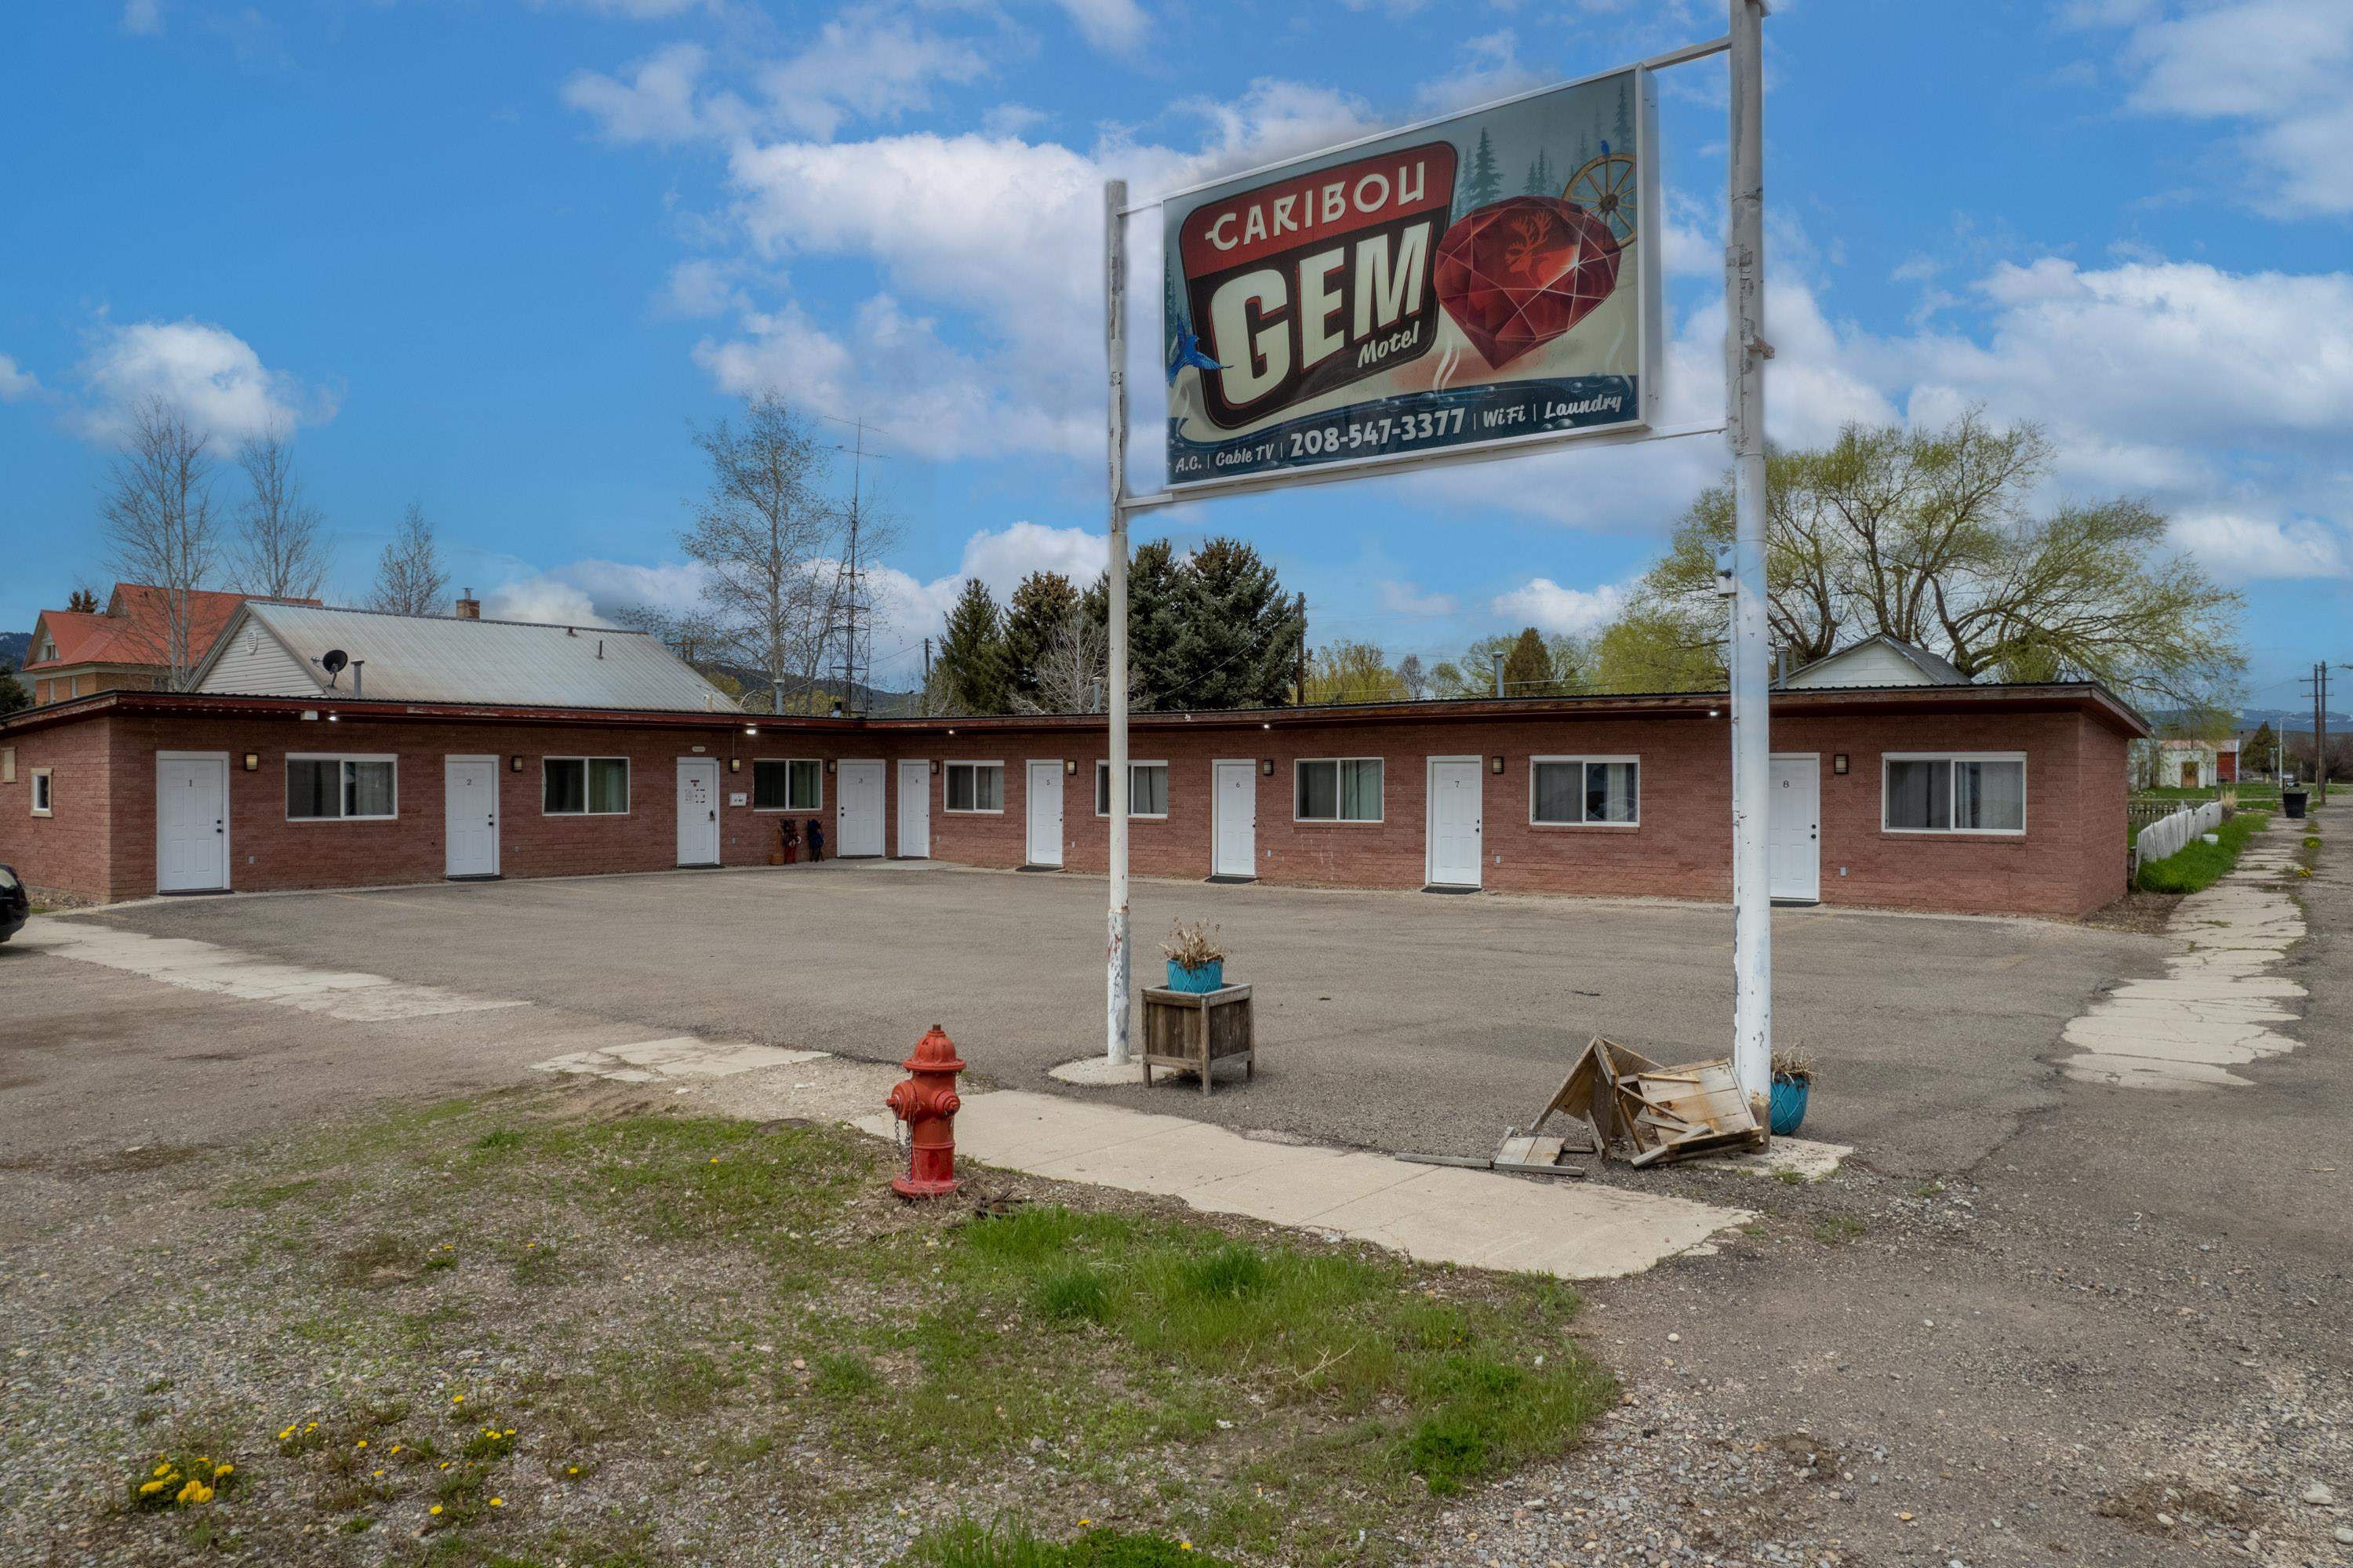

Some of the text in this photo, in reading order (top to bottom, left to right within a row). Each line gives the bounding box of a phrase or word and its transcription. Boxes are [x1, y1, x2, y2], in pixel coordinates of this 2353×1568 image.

[1205, 161, 1425, 251] CARIBOU
[1210, 221, 1431, 405] GEM
[1357, 320, 1420, 369] Motel
[1175, 394, 1623, 472] A.C. Cable TV 208-547-3377 WiFi Laundry
[1235, 780, 1241, 788] 6
[1783, 780, 1790, 788] 8
